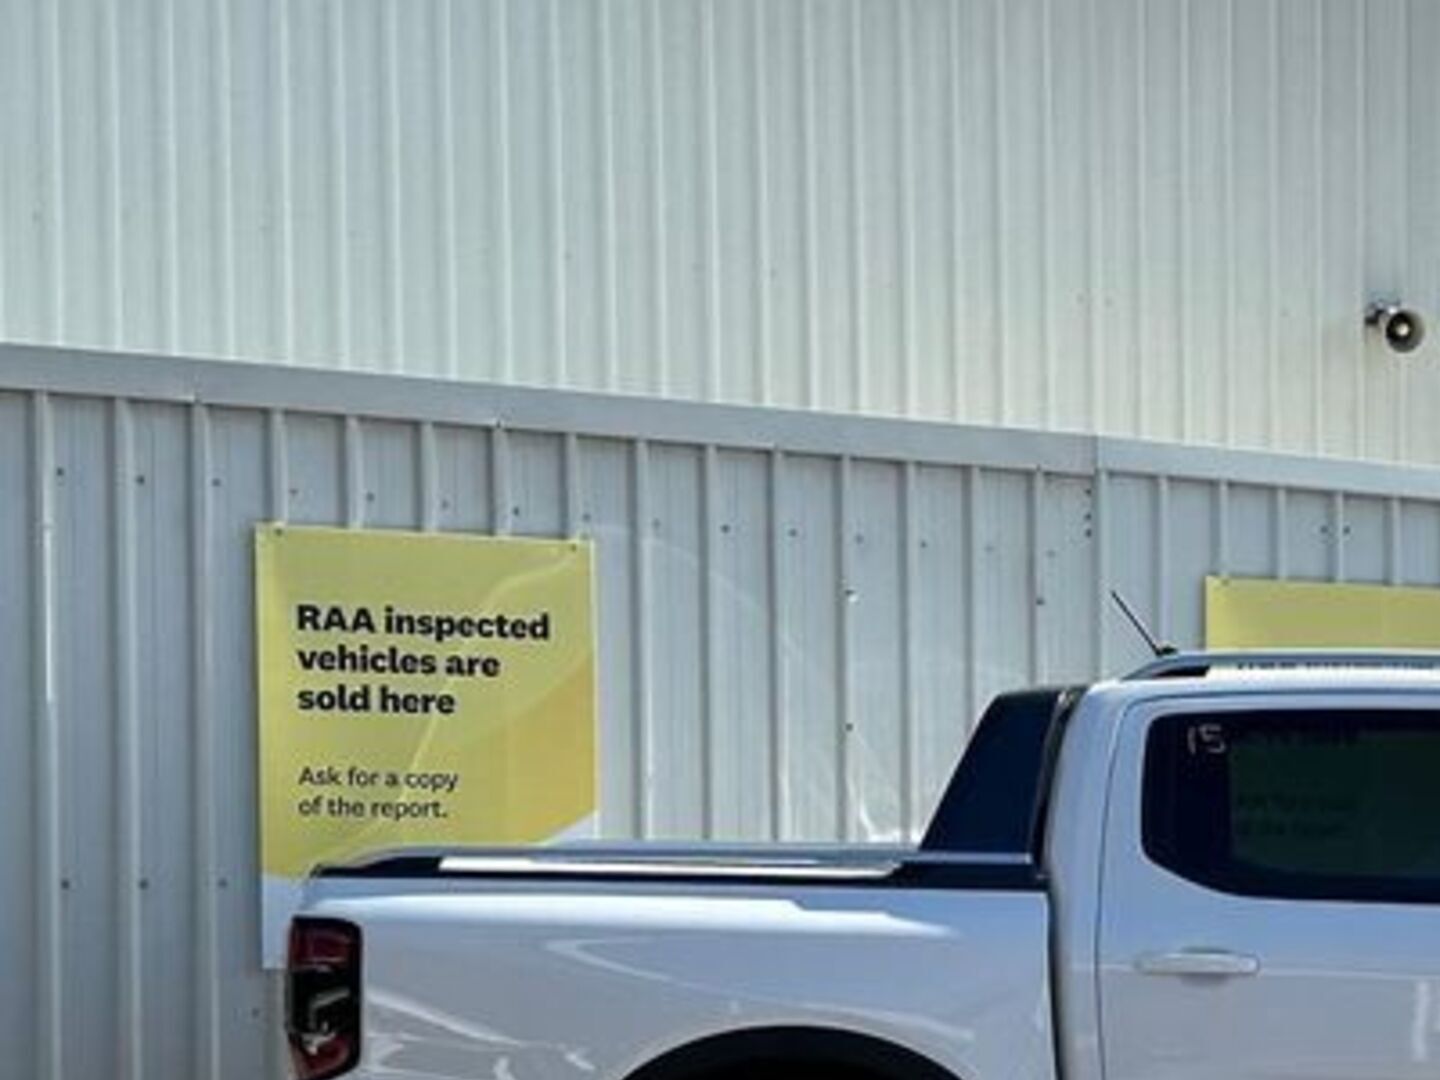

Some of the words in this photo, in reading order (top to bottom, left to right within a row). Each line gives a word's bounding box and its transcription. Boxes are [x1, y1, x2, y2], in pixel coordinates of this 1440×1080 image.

[297, 604, 376, 634] RAA
[384, 606, 550, 642] inspected
[297, 644, 437, 675] vehicles
[445, 654, 500, 677] are
[297, 684, 370, 712] sold
[380, 686, 455, 714] here
[298, 766, 341, 787] Ask
[347, 766, 378, 788] for
[385, 773, 398, 788] a
[404, 773, 458, 793] copy
[298, 795, 323, 816] of
[327, 796, 365, 817] the
[370, 800, 448, 821] report.
